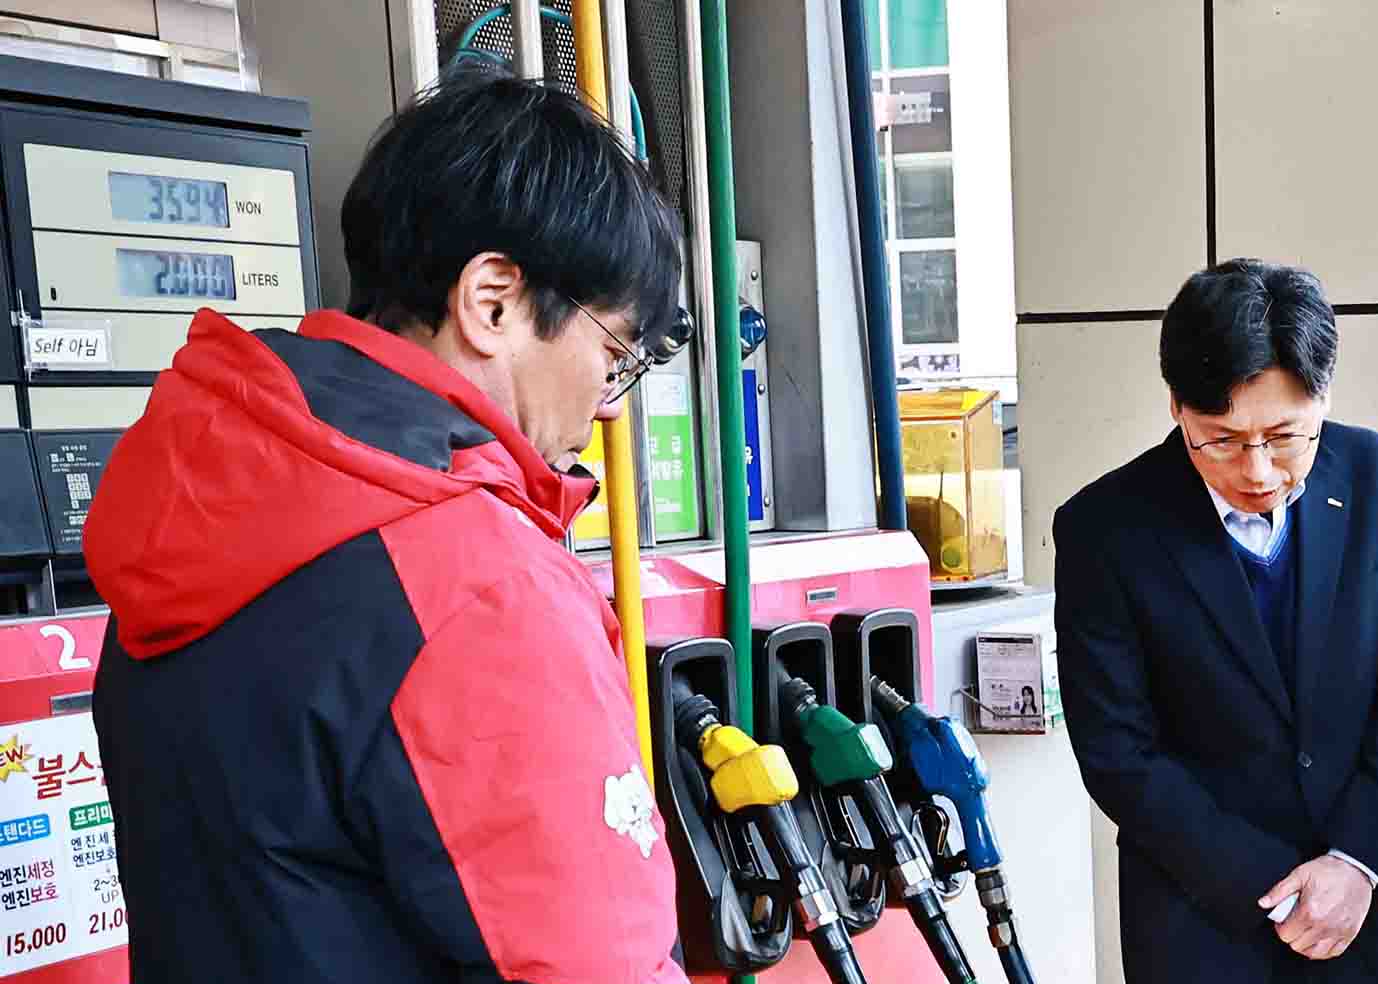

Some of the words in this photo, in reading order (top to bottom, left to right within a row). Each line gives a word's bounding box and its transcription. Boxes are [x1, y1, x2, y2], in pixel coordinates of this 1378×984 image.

[236, 201, 262, 215] WON
[242, 273, 279, 287] LITERS
[34, 338, 63, 353] Self
[69, 337, 98, 357] 아님
[39, 624, 92, 671] 2
[0, 745, 24, 768] EW
[31, 751, 107, 800] 불스
[0, 859, 55, 888] 엔진세정
[2, 882, 60, 911] 엔진보호
[101, 889, 120, 904] UP
[89, 907, 129, 935] 21,0
[6, 922, 67, 956] 15,000
